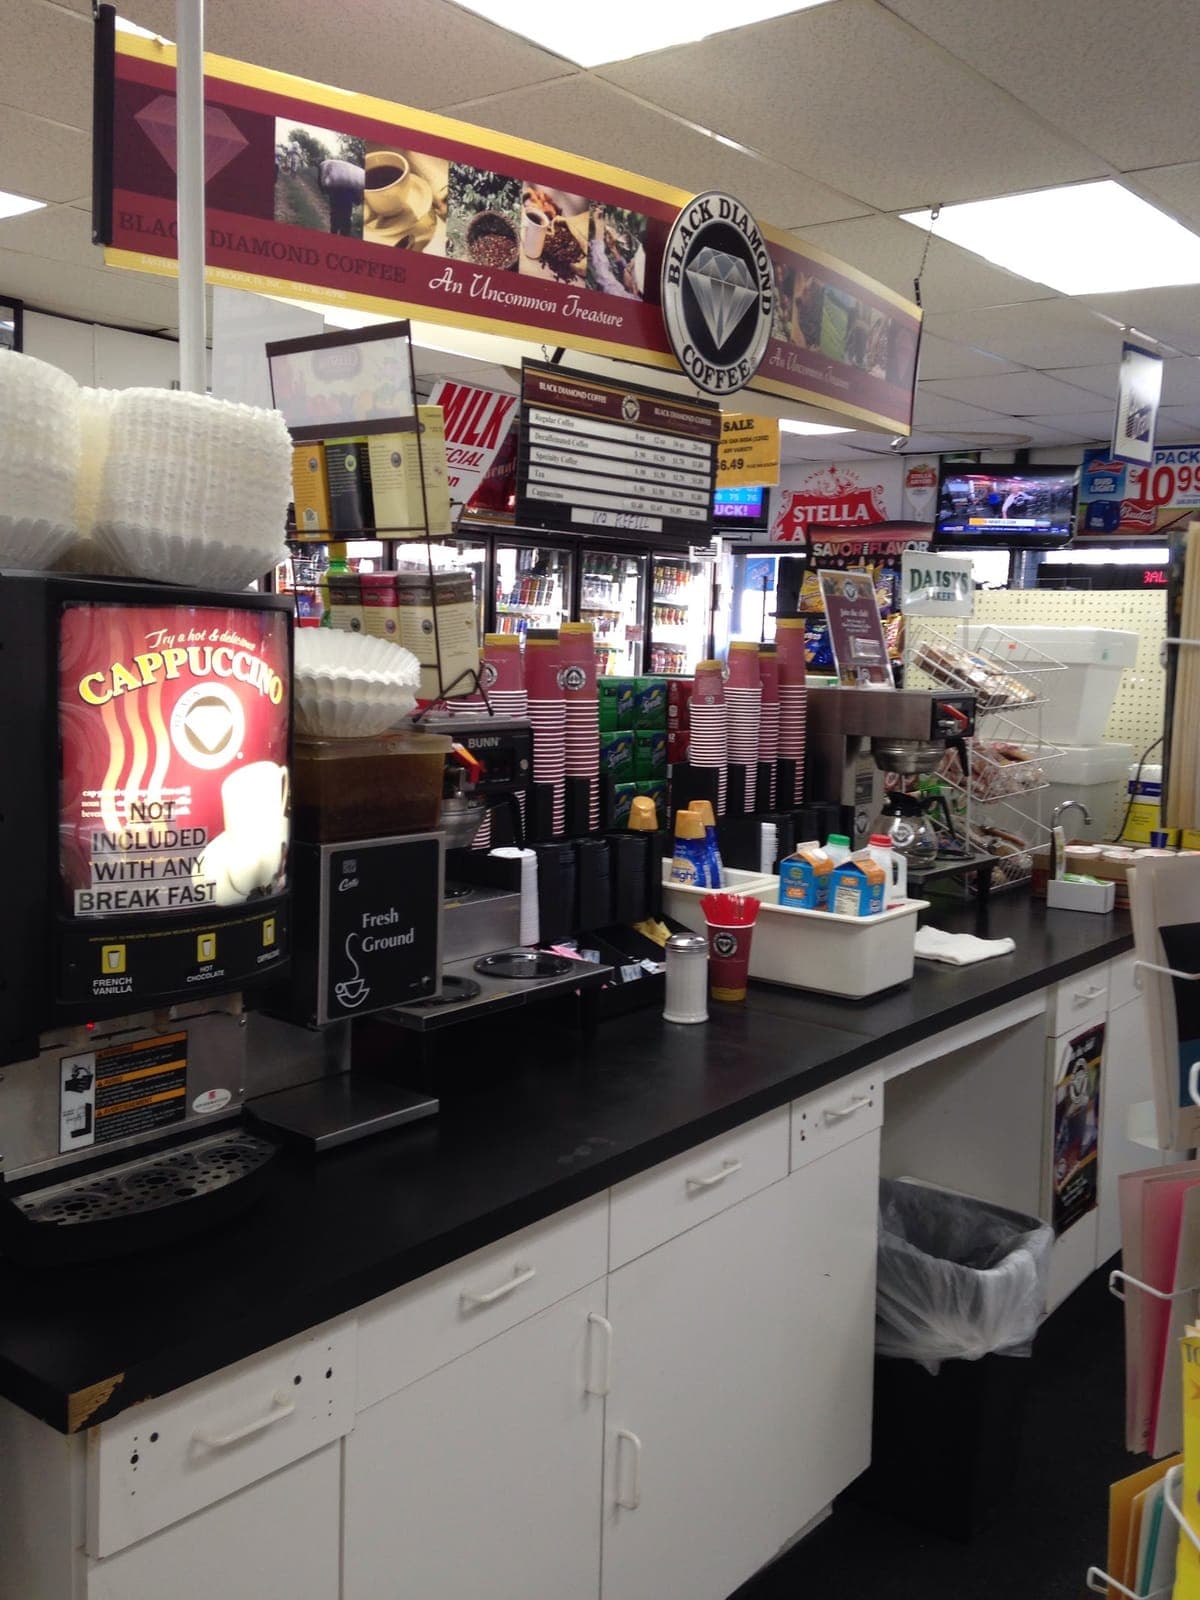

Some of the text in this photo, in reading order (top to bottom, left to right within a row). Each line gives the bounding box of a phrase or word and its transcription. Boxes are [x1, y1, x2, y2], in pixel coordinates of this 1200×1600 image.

[119, 212, 407, 284] BLAC DIAMOND COFFEE
[667, 198, 771, 316] BLACK DIAMOND
[428, 267, 624, 327] An Uncommon Treasure
[683, 344, 750, 389] COFFEE
[539, 382, 557, 393] BLACK
[558, 384, 586, 399] DIAMOND
[587, 392, 607, 404] COFFEE
[435, 382, 518, 450] MILK
[654, 407, 667, 418] BLACK
[723, 420, 754, 431] SALE
[715, 505, 748, 516] UCK!
[793, 503, 869, 522] STELLA
[813, 542, 861, 557] SAVOR
[144, 628, 175, 648] Try
[178, 633, 185, 643] a
[188, 628, 206, 641] hot
[208, 628, 219, 641] &
[79, 646, 283, 704] CAPPUCCINO
[468, 737, 499, 748] BUNN
[131, 801, 175, 820] NOT
[93, 828, 206, 852] INCLUDED
[95, 856, 204, 881] WITH ANY
[79, 883, 216, 911] BREAK FAST
[362, 907, 399, 928] Fresh
[362, 927, 415, 952] Ground
[93, 976, 133, 988] FRENCH
[187, 969, 225, 982] CHOCOLATE
[93, 985, 133, 996] VANILLA
